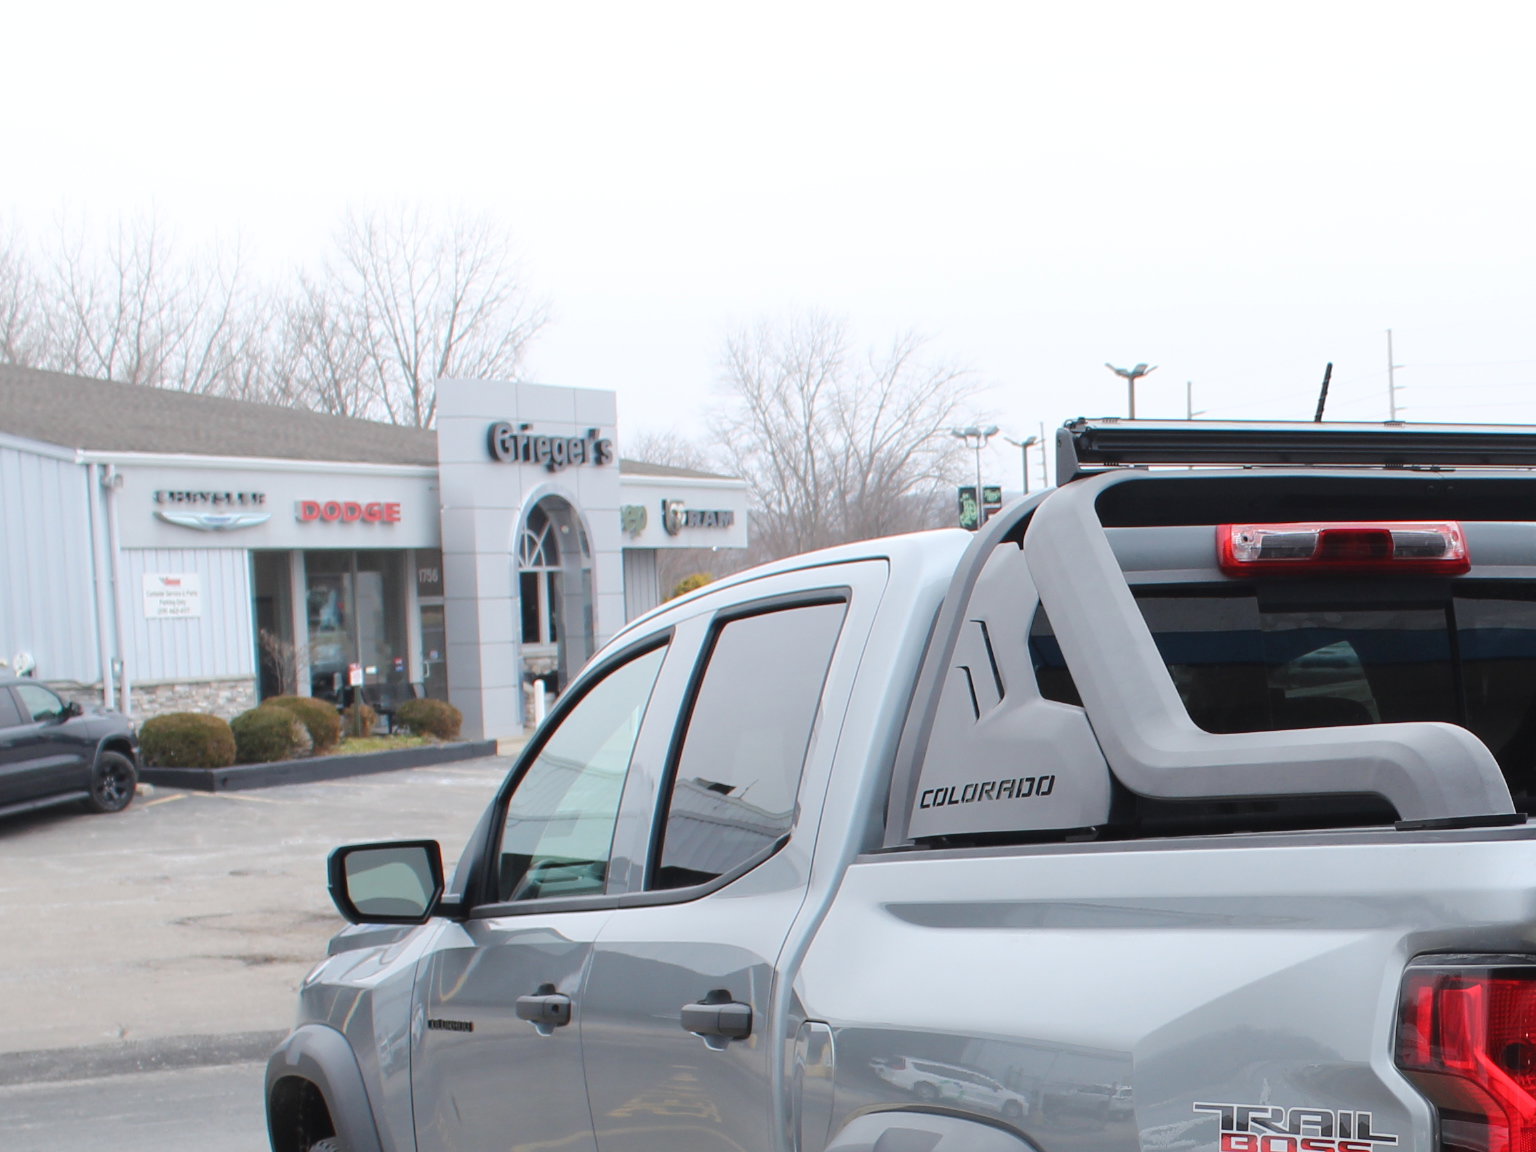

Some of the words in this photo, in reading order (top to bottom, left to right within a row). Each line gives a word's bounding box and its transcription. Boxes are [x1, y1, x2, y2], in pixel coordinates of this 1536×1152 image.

[487, 421, 613, 472] Grieger's
[299, 500, 402, 523] DODGE
[685, 509, 735, 528] RAM
[919, 774, 1056, 810] COLORADO
[1193, 1102, 1399, 1146] TRAIL
